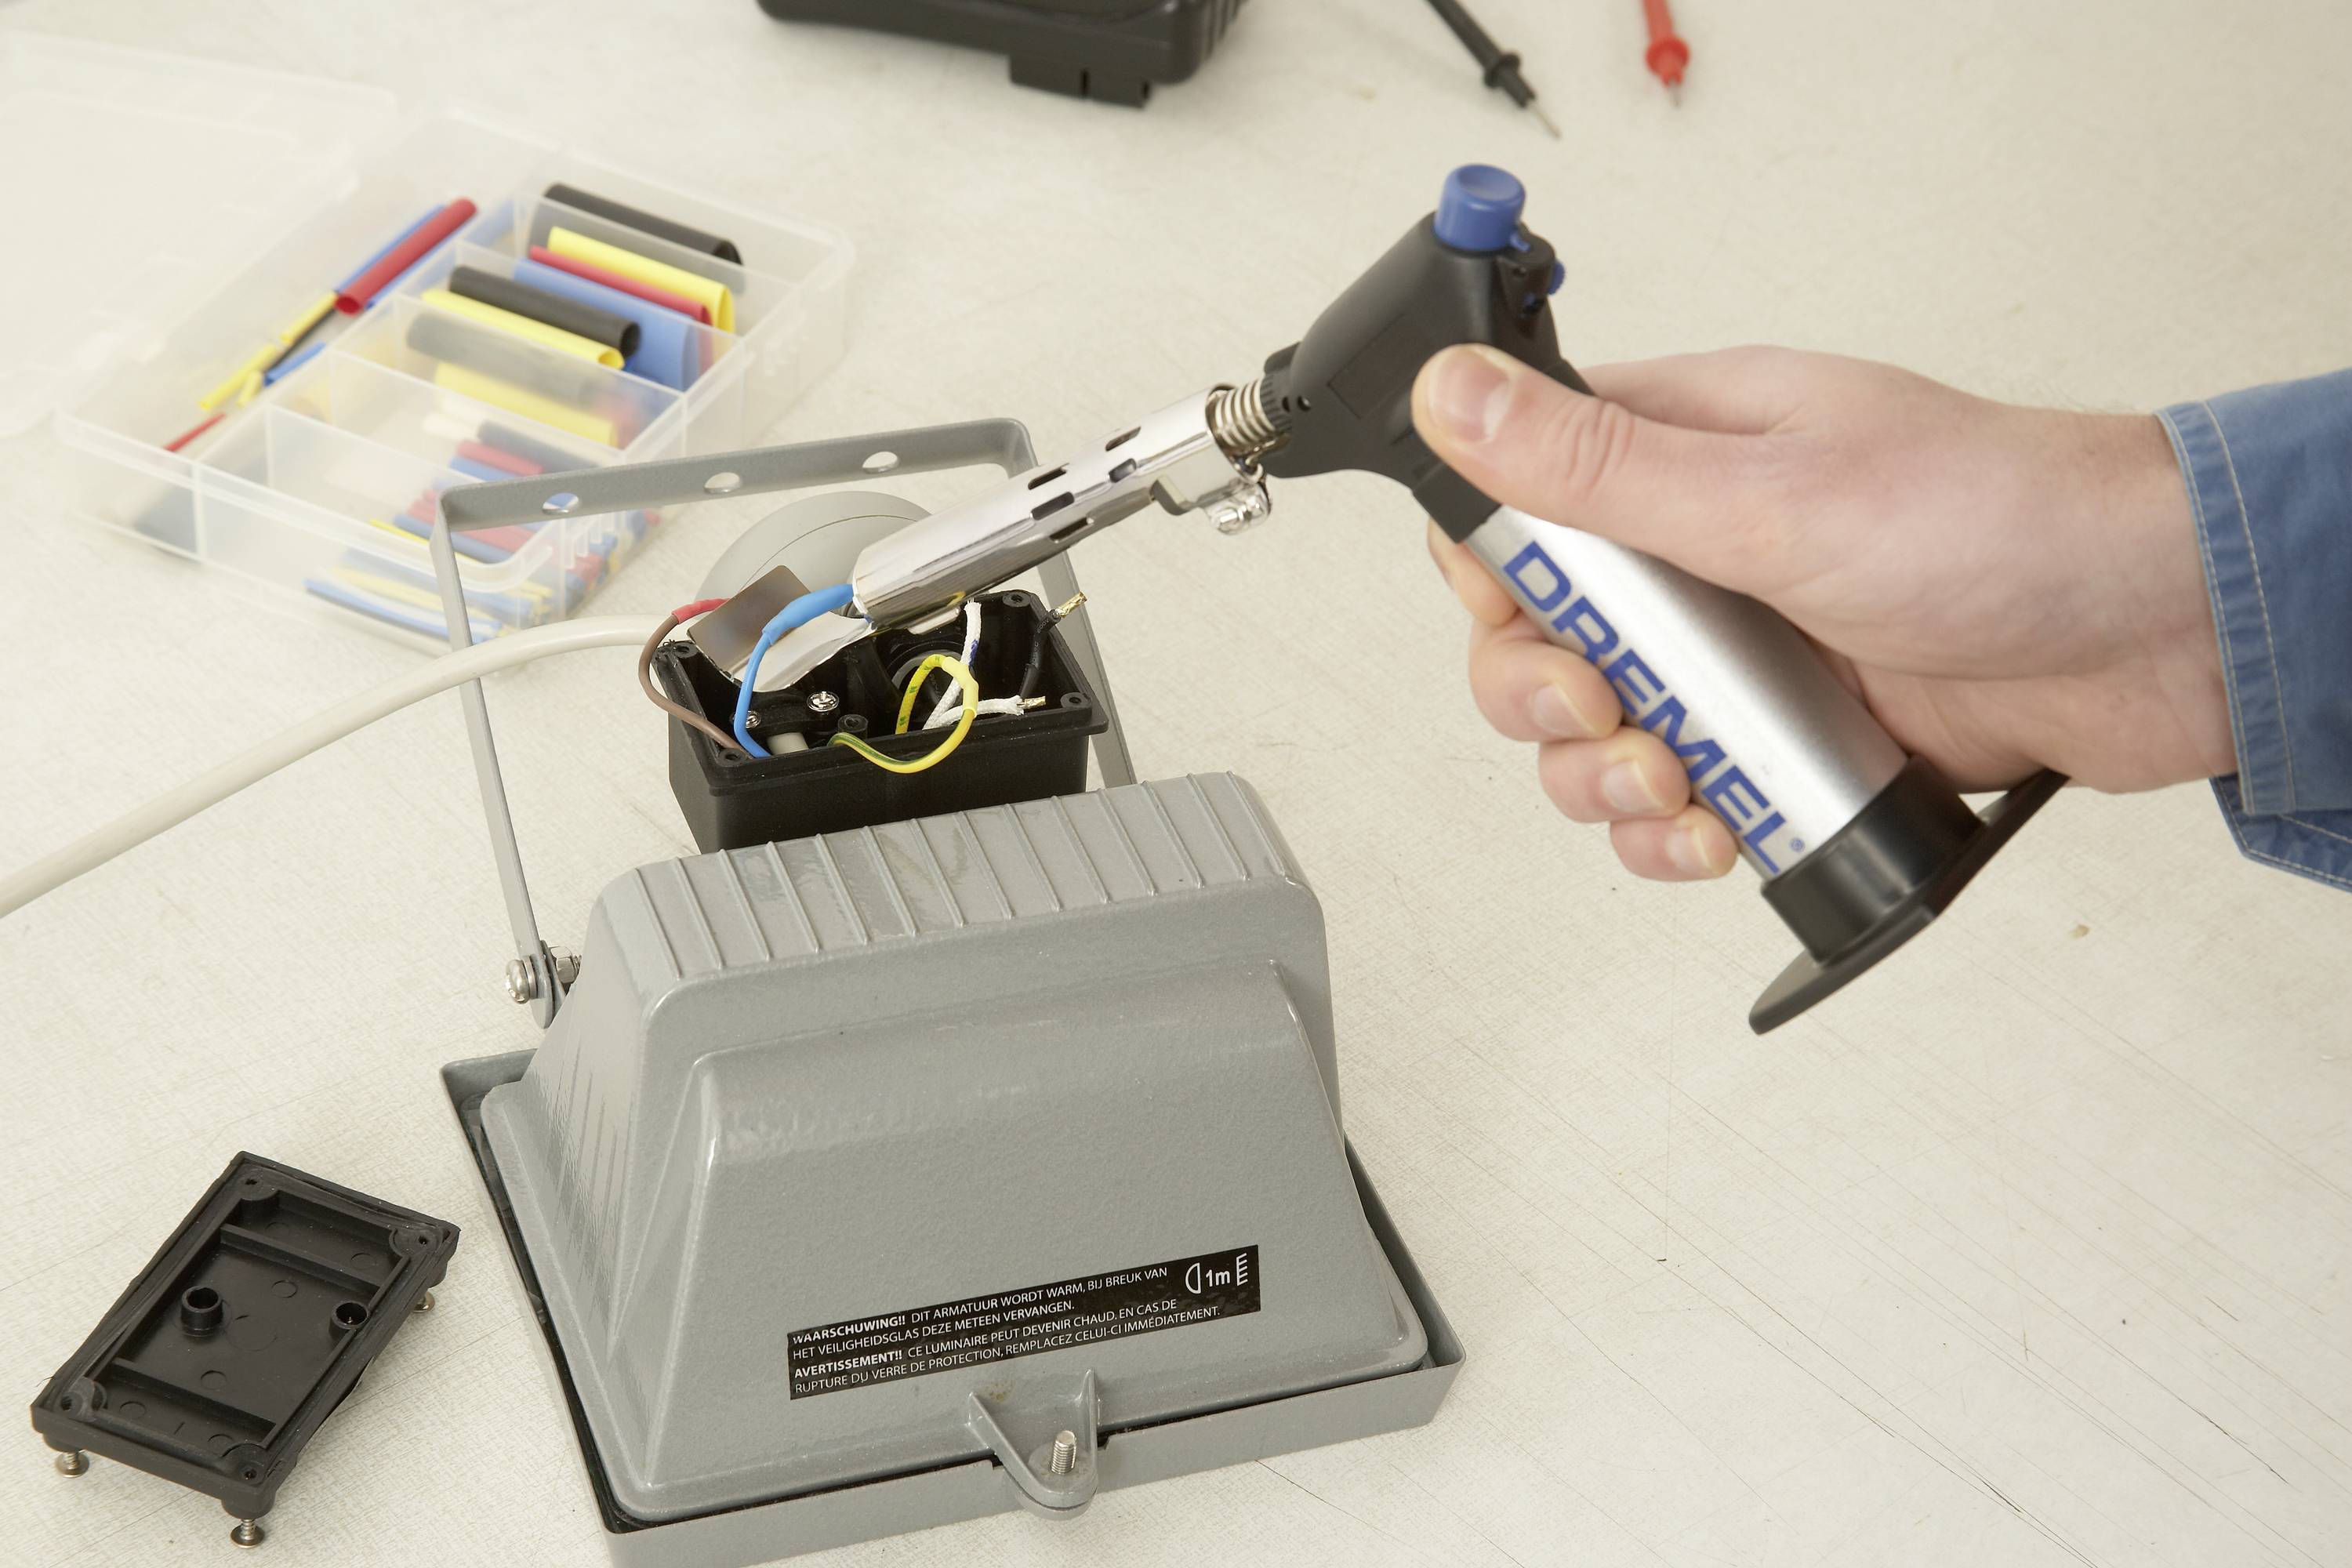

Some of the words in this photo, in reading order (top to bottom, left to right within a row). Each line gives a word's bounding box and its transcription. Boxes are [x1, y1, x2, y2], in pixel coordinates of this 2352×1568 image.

[793, 1315, 906, 1345] WAARSCHUWING!!
[911, 1310, 931, 1323] DIT
[933, 1298, 998, 1319] ARMATUUR
[1000, 1290, 1044, 1307] WORDT
[1046, 1283, 1086, 1299] WARM,
[1087, 1279, 1102, 1291] BIJ
[1105, 1272, 1142, 1287] BREUK
[1144, 1267, 1167, 1280] VAN
[1206, 1269, 1231, 1287] 1m
[793, 1346, 815, 1360] HET
[818, 1328, 920, 1356] VEILIGHEIDSGLAS
[922, 1323, 952, 1338] DEZE
[955, 1312, 1001, 1331] METEEN
[1003, 1300, 1075, 1322] VERVANGEN.
[794, 1349, 903, 1379] AVERTISSEMENT!!
[908, 1346, 924, 1358] CE
[925, 1334, 988, 1355] LUMINAIRE
[991, 1328, 1020, 1342] PEUT
[1022, 1318, 1072, 1337] DEVENIR
[1073, 1311, 1117, 1327] CHAUD.
[1120, 1307, 1134, 1319] EN
[1136, 1304, 1160, 1316] CAS
[1162, 1298, 1178, 1310] DE
[795, 1375, 848, 1393] RUPTURE
[851, 1372, 869, 1384] DU
[871, 1364, 907, 1380] VERRE
[910, 1361, 926, 1373] DE
[928, 1347, 1004, 1370] PROTECTION,
[1006, 1333, 1073, 1355] REMPLACEZ
[1075, 1325, 1121, 1341] CELUI-CI
[1124, 1305, 1221, 1334] IMMÉDIATEMENT.
